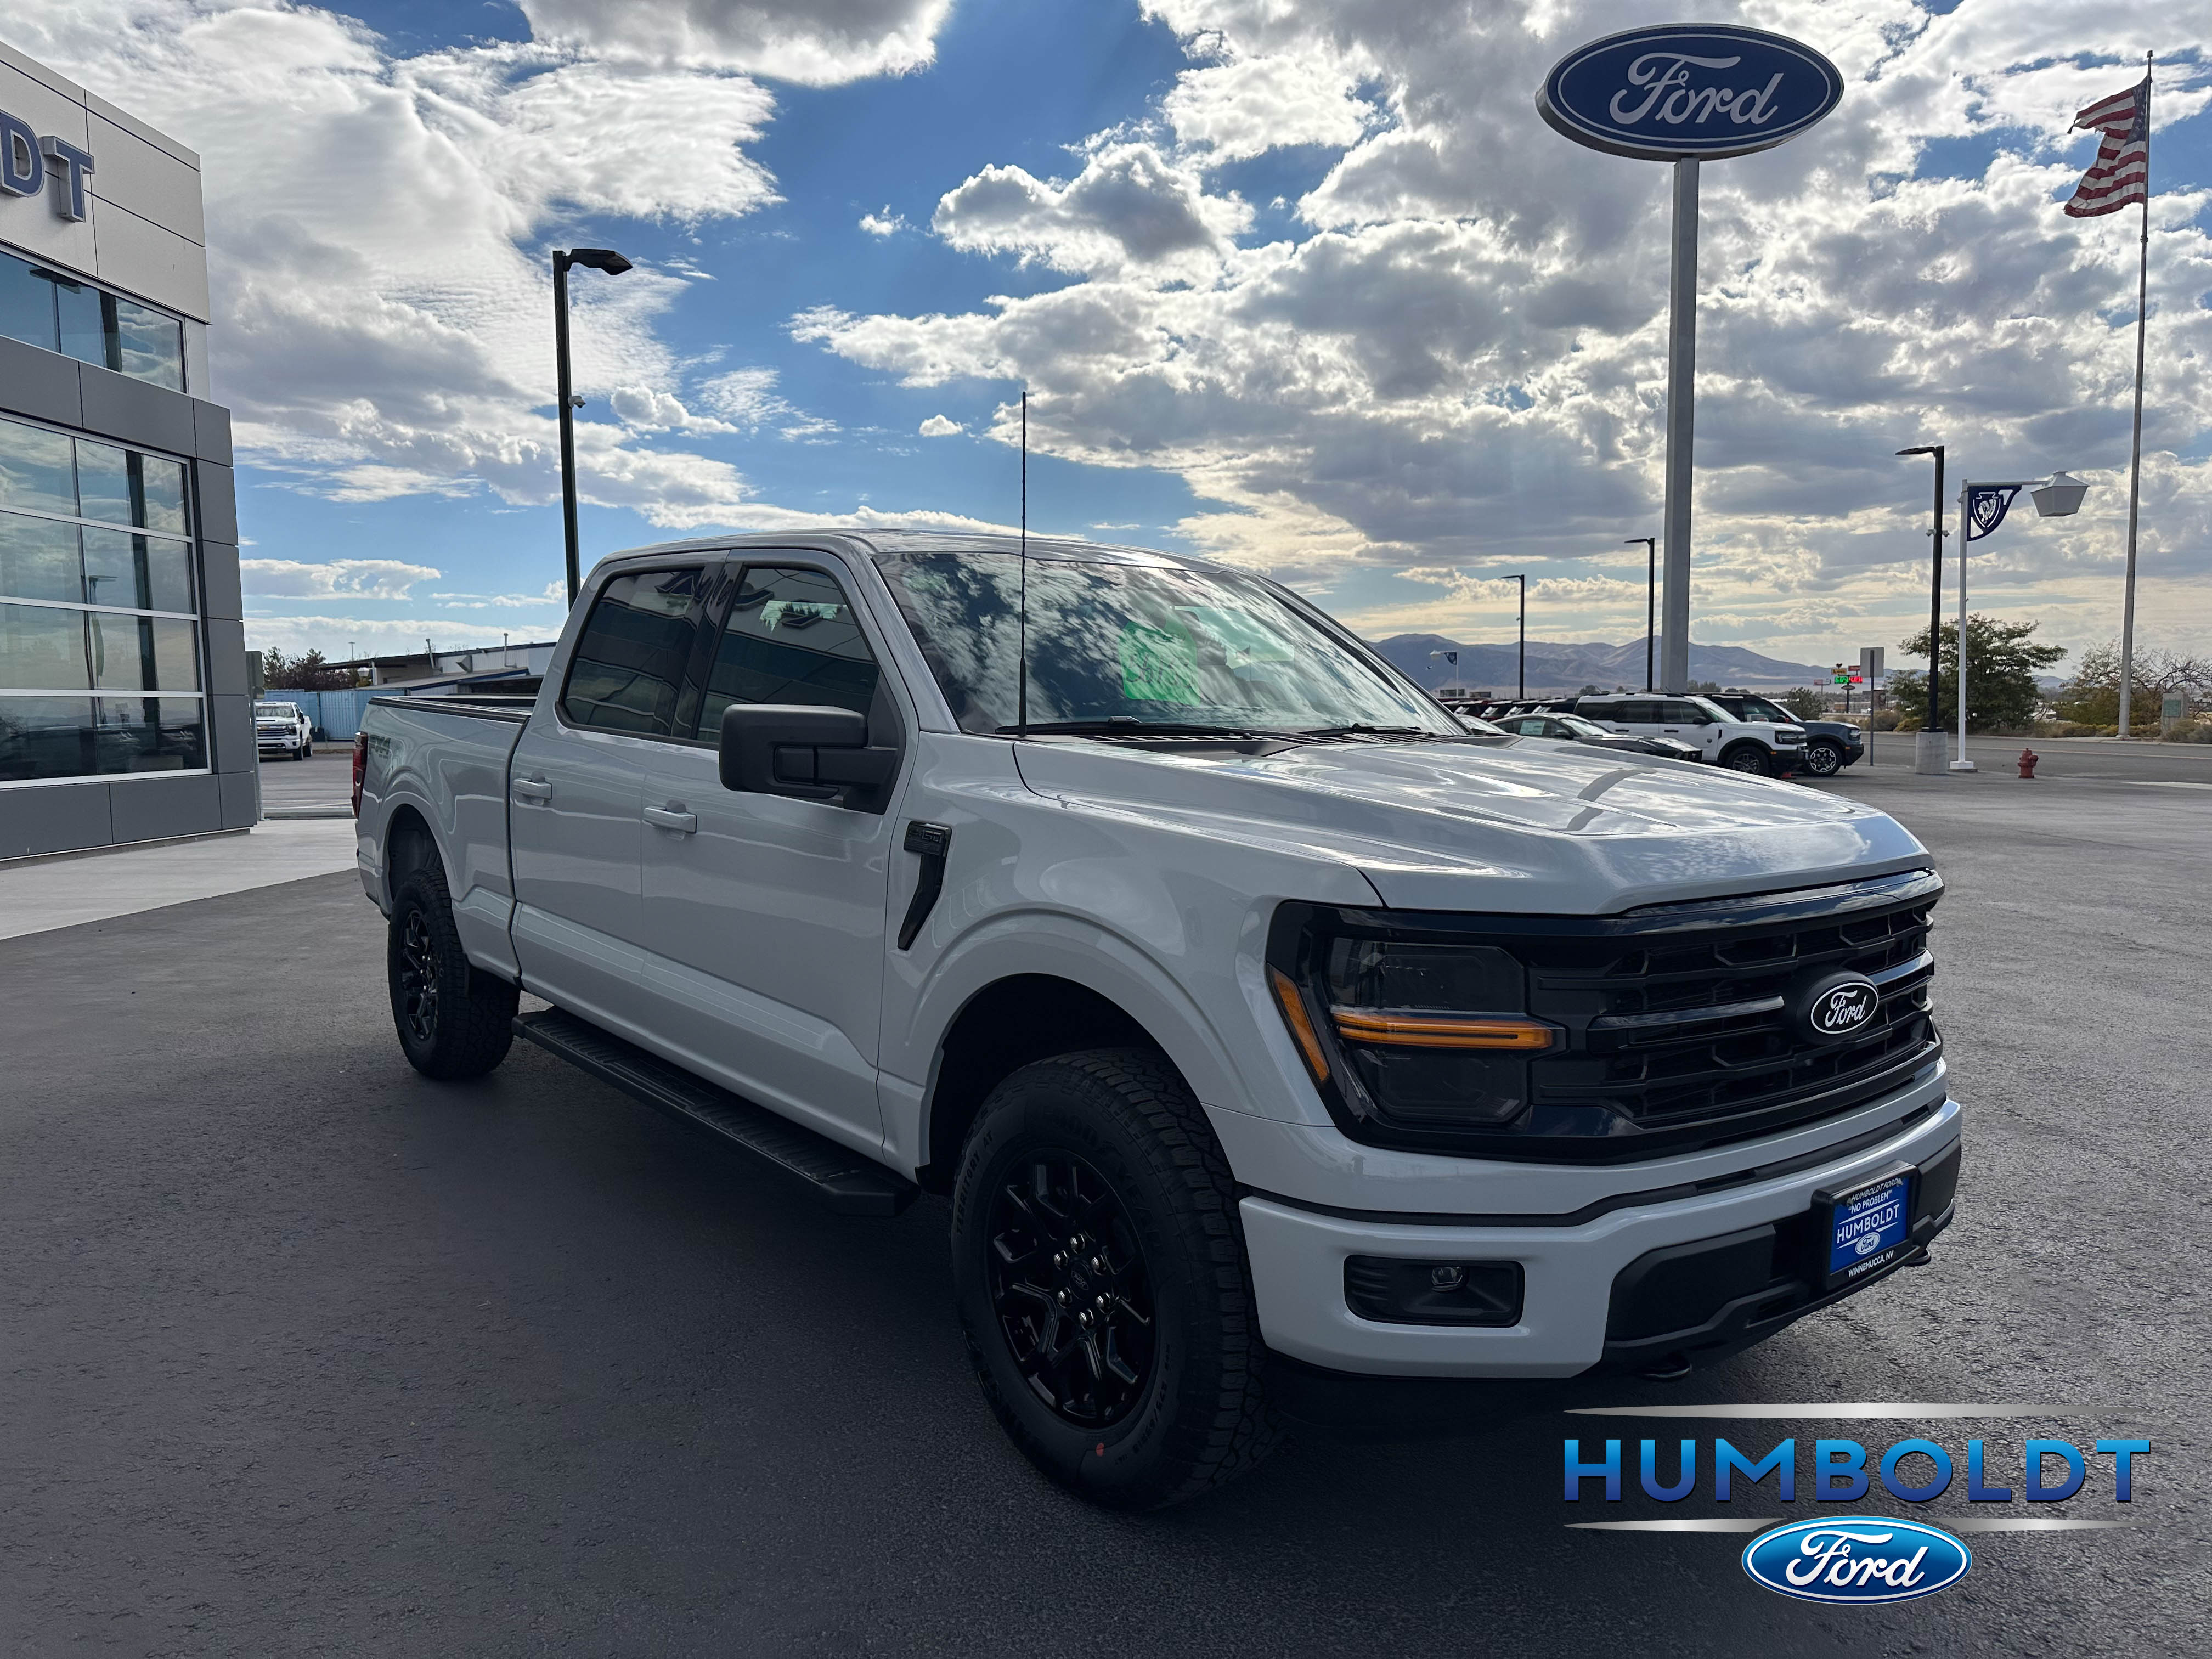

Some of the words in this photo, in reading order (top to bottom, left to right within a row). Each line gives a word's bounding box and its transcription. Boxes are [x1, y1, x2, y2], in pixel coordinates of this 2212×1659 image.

[1609, 52, 1784, 125] Ford
[1825, 990, 1867, 1028] Ford
[956, 1149, 980, 1235] TERRITORY
[983, 1130, 993, 1149] AT
[1837, 1204, 1900, 1244] HUMBOLDT
[1860, 1237, 1875, 1251] Ford
[1886, 1250, 1894, 1260] NV
